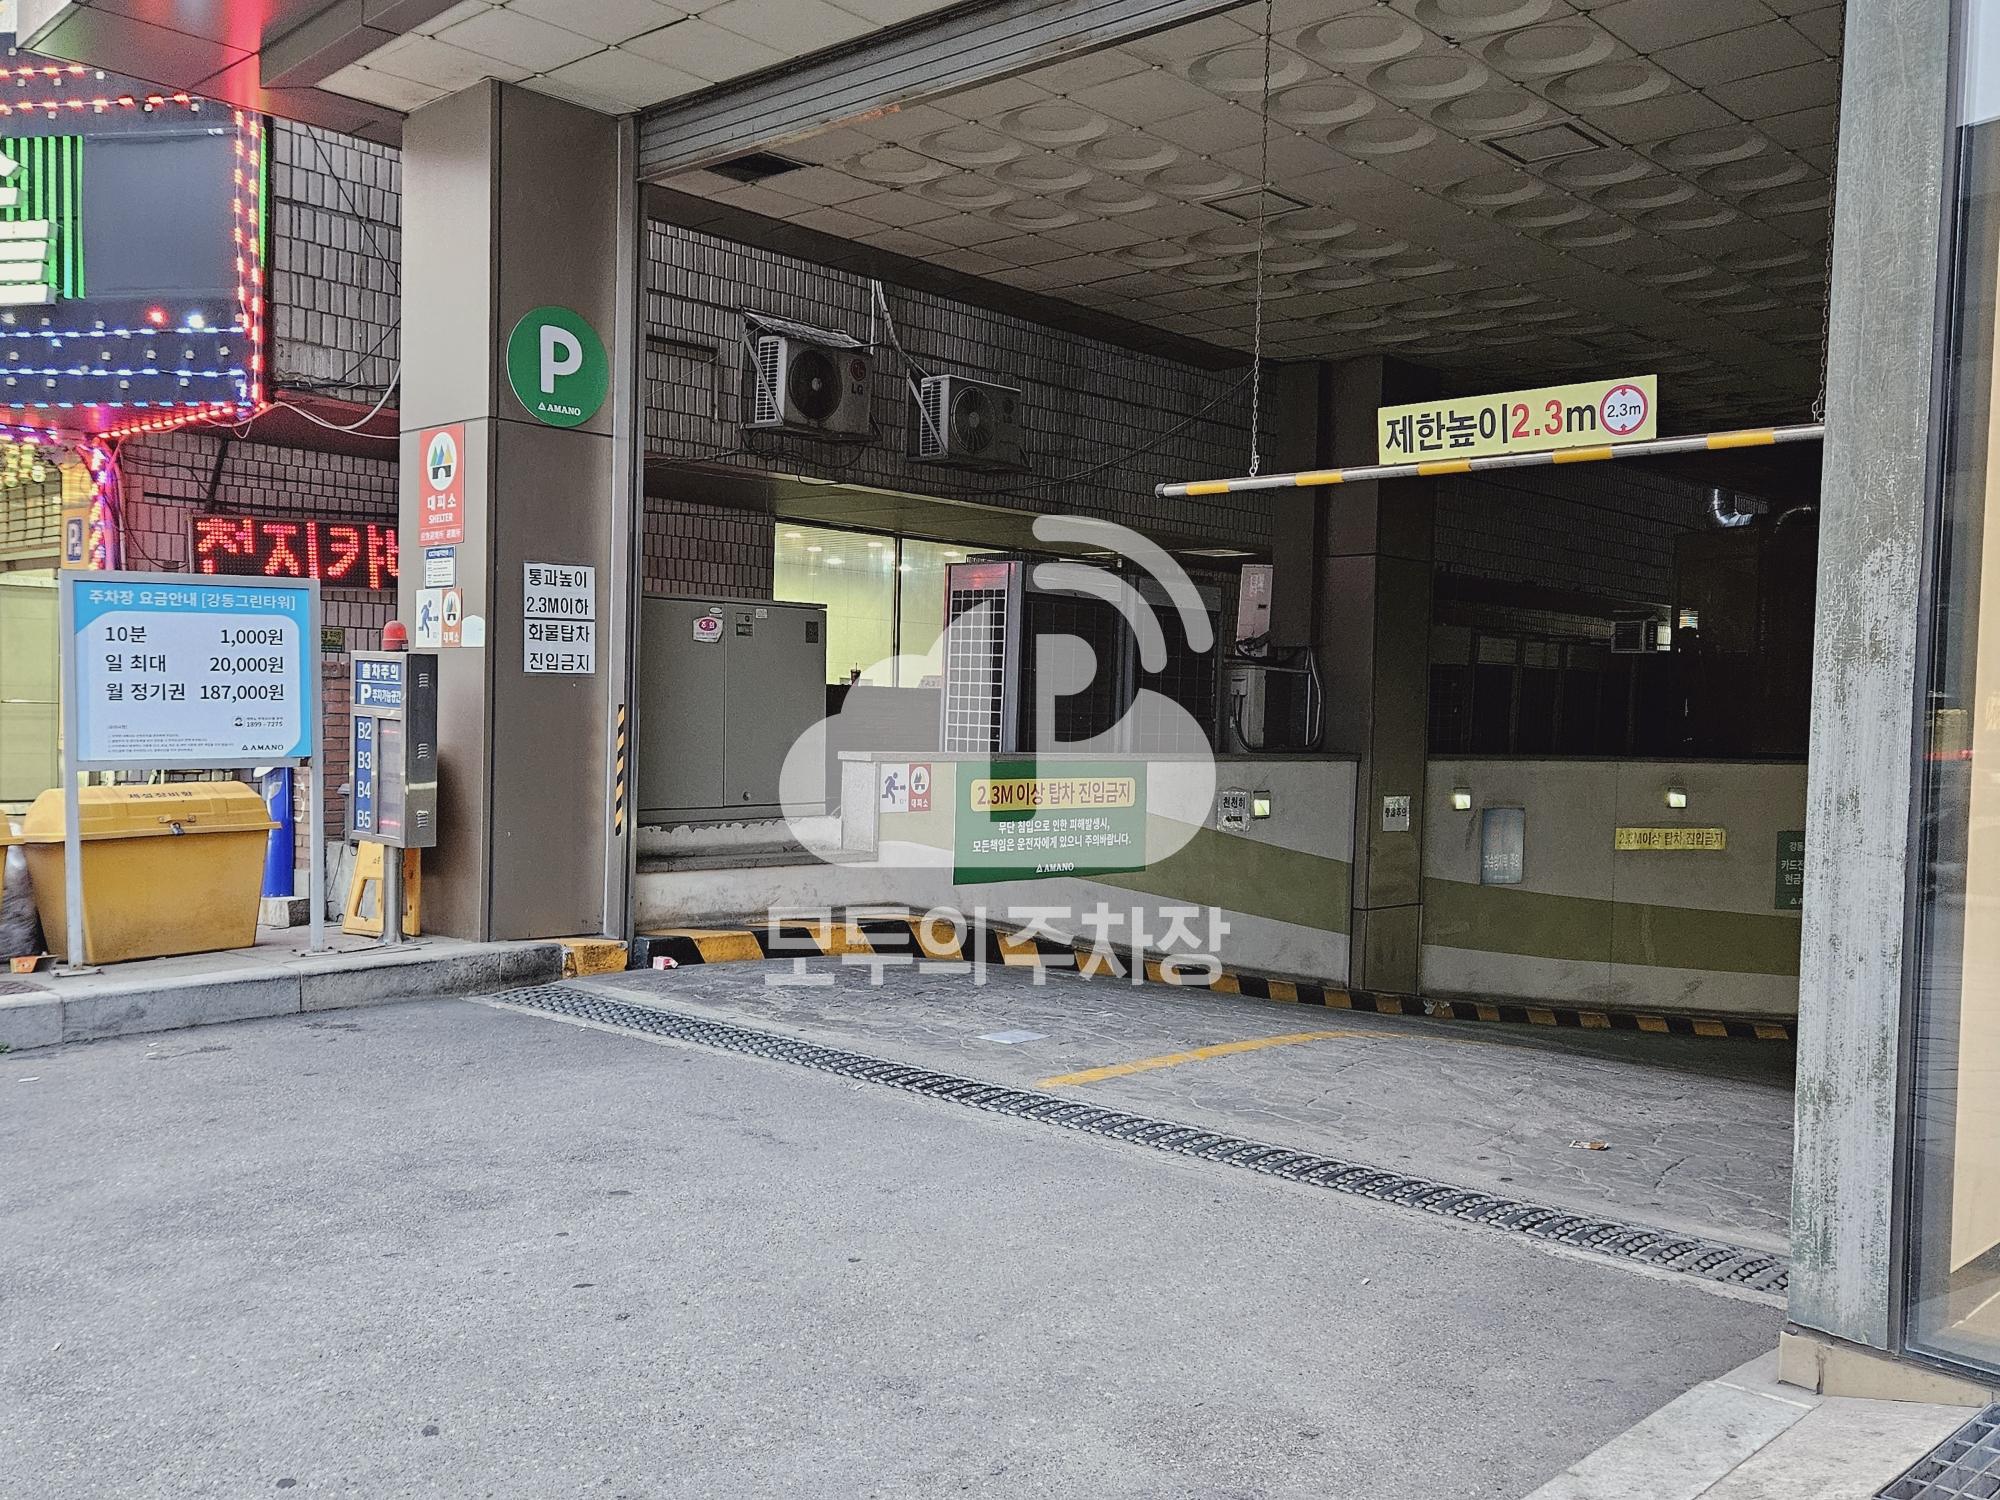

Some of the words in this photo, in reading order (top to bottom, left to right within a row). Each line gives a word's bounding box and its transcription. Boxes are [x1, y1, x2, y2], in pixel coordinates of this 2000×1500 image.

[540, 324, 583, 394] P
[851, 384, 864, 396] LG
[547, 403, 581, 416] AMANO
[1607, 403, 1641, 418] 2.3m
[1385, 399, 1597, 453] 제한높이2.3m
[427, 492, 457, 511] 대피소
[428, 512, 453, 524] SHELTER
[528, 568, 587, 588] 통과높이
[88, 589, 134, 606] 주차장
[138, 591, 198, 608] 요금안내
[526, 596, 589, 615] 2.3M이하
[104, 625, 148, 644] 10분
[220, 628, 284, 647] 1,000원
[528, 623, 590, 643] 화물탑차
[105, 653, 122, 672] 일
[130, 653, 167, 673] 최대
[209, 656, 284, 675] 20,000원
[362, 662, 399, 680] 출차주의
[529, 652, 589, 671] 진입금지
[106, 682, 123, 701] 월
[130, 682, 186, 701] 정기권
[199, 683, 285, 704] 187,000원
[360, 683, 372, 705] P
[357, 721, 372, 740] B2
[357, 750, 371, 770] B3
[357, 780, 371, 799] B4
[977, 784, 1013, 805] 2.3M
[1016, 782, 1045, 805] 이상
[1049, 781, 1075, 805] 탑차
[1078, 780, 1130, 804] 진입금지
[910, 798, 929, 809] 대피소
[1223, 796, 1246, 809] 천천히
[356, 809, 371, 829] B5
[998, 820, 1015, 834] 무단
[1052, 818, 1068, 832] 인한
[972, 838, 1015, 853] 모든책임은
[1016, 836, 1058, 851] 운전자에게
[1058, 833, 1083, 848] 있으니
[1788, 841, 1805, 852] 강동
[1044, 862, 1075, 873] AMANO
[1783, 873, 1804, 885] 현금
